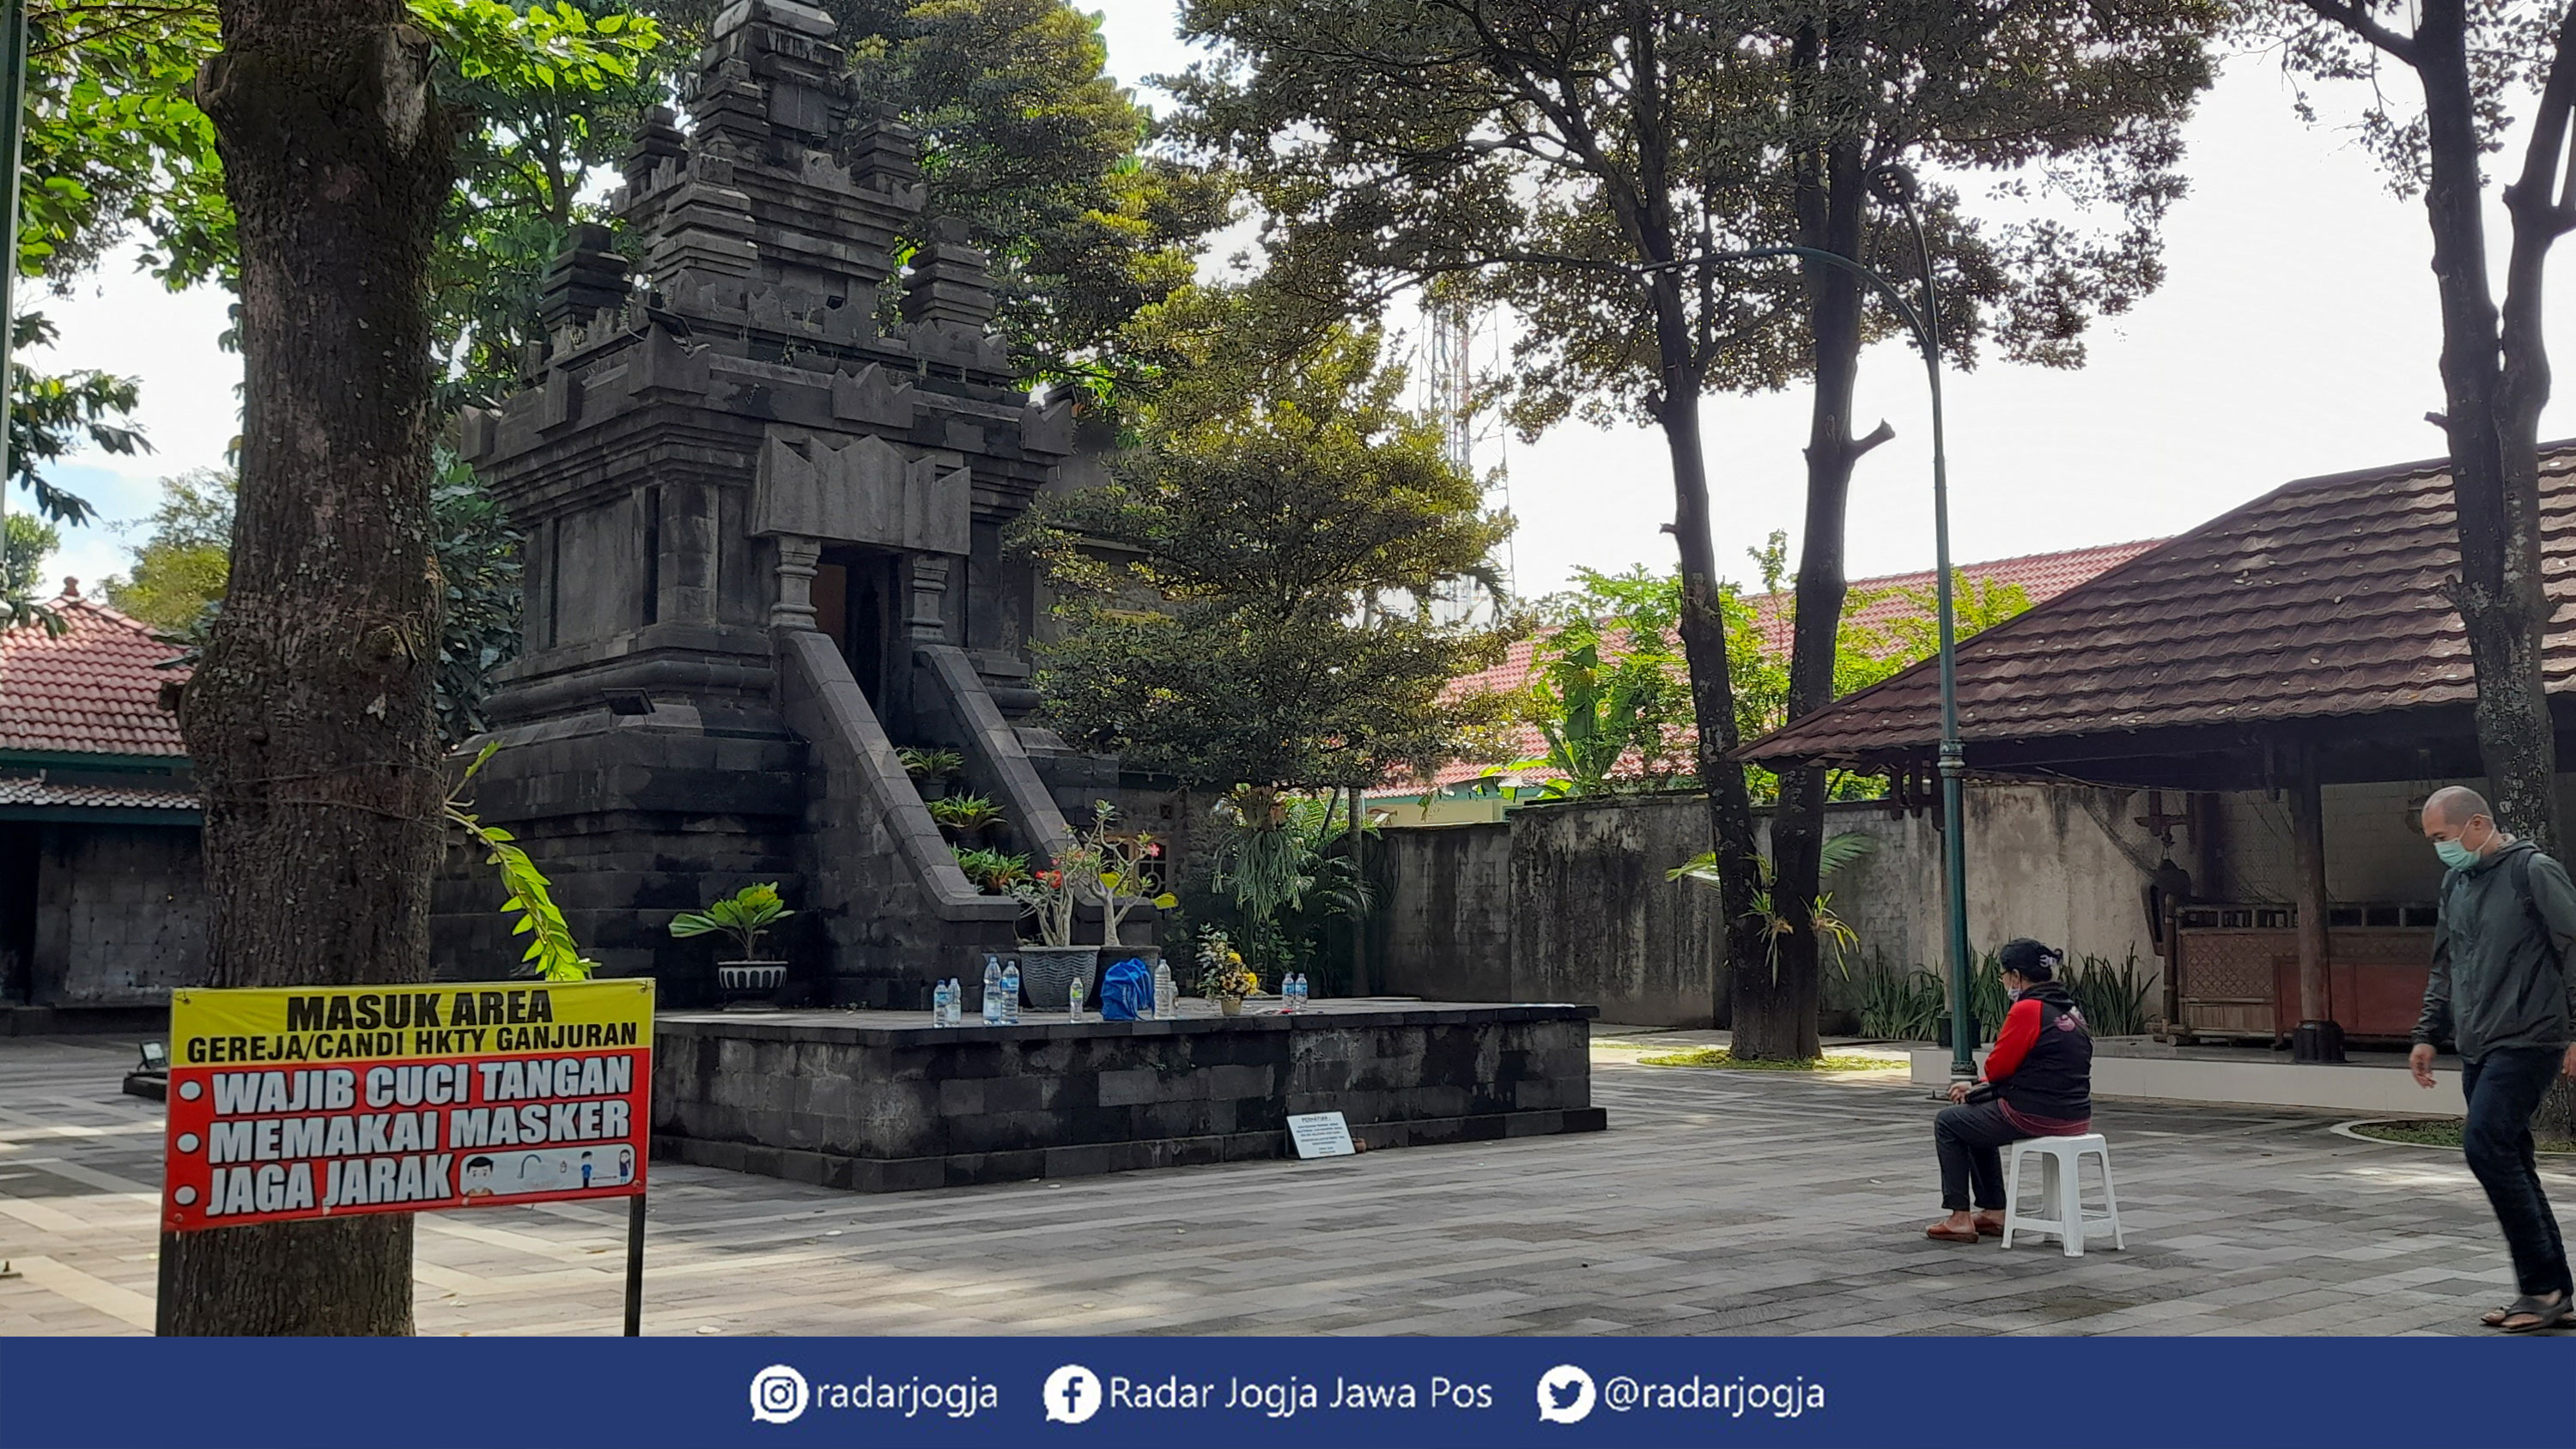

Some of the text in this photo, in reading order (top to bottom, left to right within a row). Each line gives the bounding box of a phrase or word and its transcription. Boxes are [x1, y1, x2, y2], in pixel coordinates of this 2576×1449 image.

[287, 990, 553, 1032] MASUK AREA
[187, 1022, 637, 1063] GEREJA/CANDI HKTY GANJURAN
[212, 1056, 632, 1115] WAJIB CUCI TANGAN
[208, 1100, 630, 1164] MEMAKAI MASKER
[205, 1154, 453, 1216] JAGA JARAK
